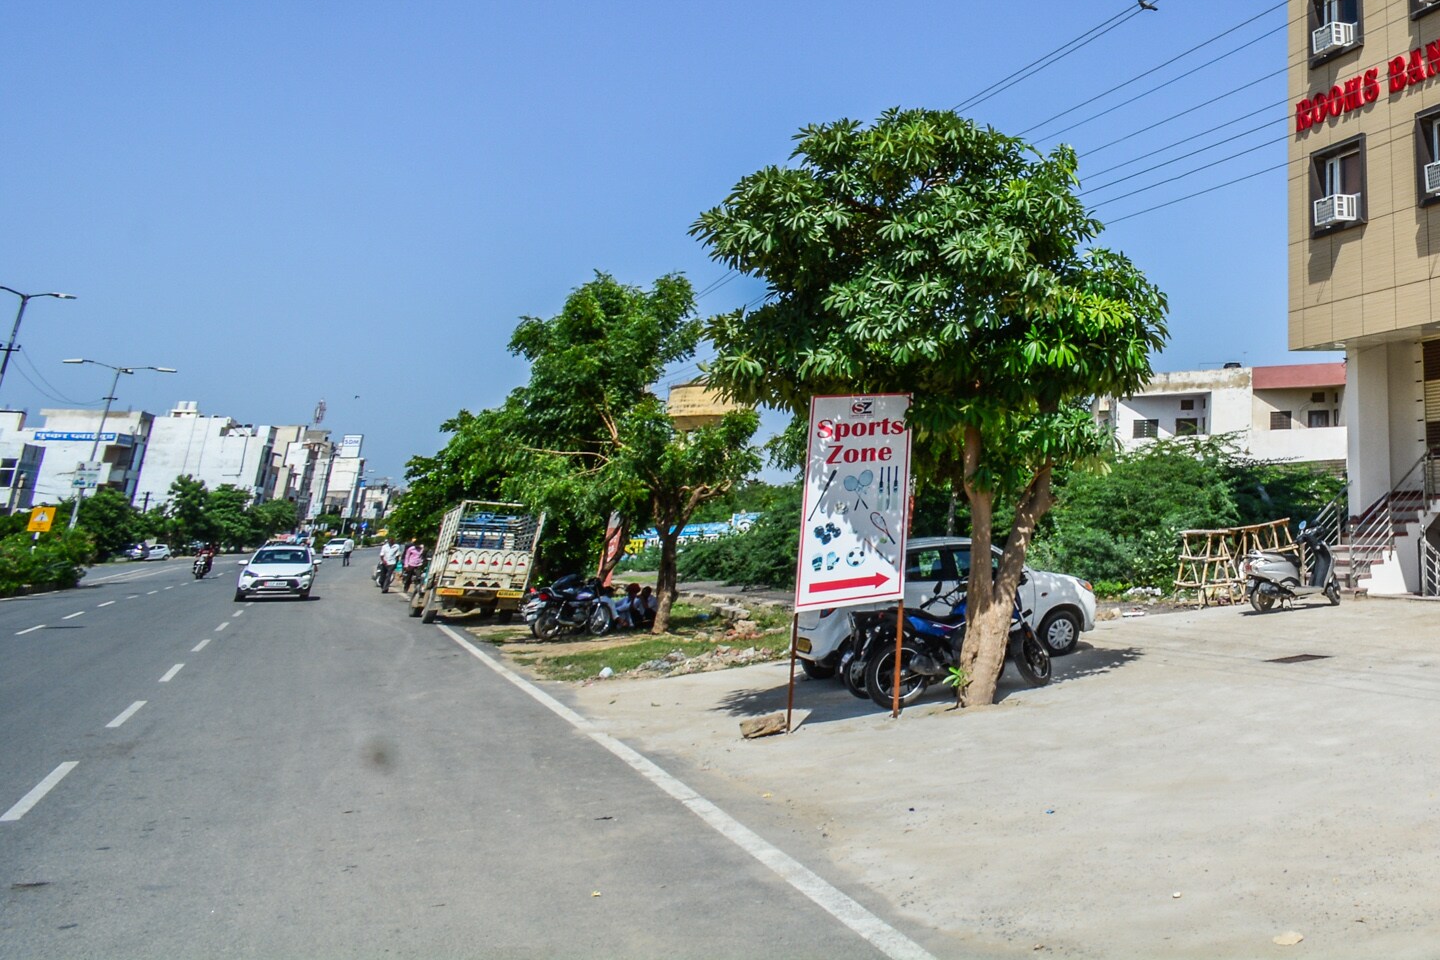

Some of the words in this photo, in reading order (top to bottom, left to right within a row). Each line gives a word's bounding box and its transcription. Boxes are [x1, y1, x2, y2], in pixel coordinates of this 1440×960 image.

[1296, 67, 1380, 132] ROOMS
[817, 418, 904, 441] Sports
[826, 445, 892, 464] Zone
